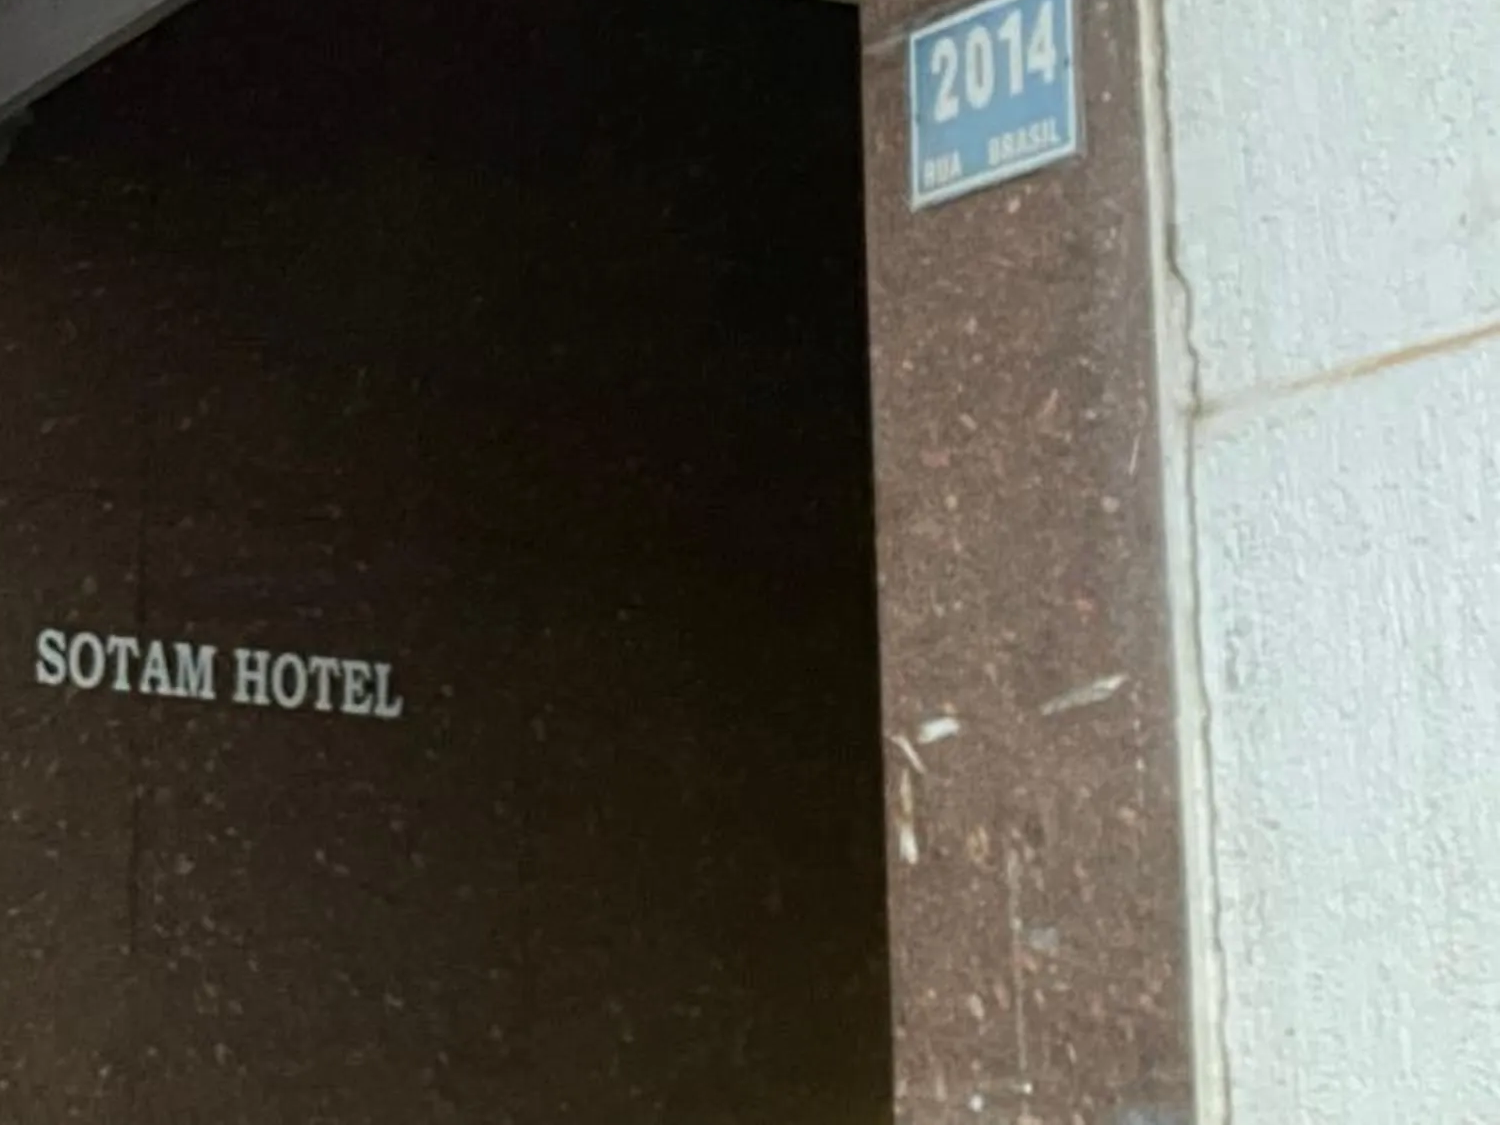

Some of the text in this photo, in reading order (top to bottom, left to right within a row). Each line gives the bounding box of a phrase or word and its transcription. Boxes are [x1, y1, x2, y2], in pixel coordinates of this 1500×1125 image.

[923, 115, 1061, 188] RUA BRASIL
[36, 627, 404, 718] SOTAM HOTEL
